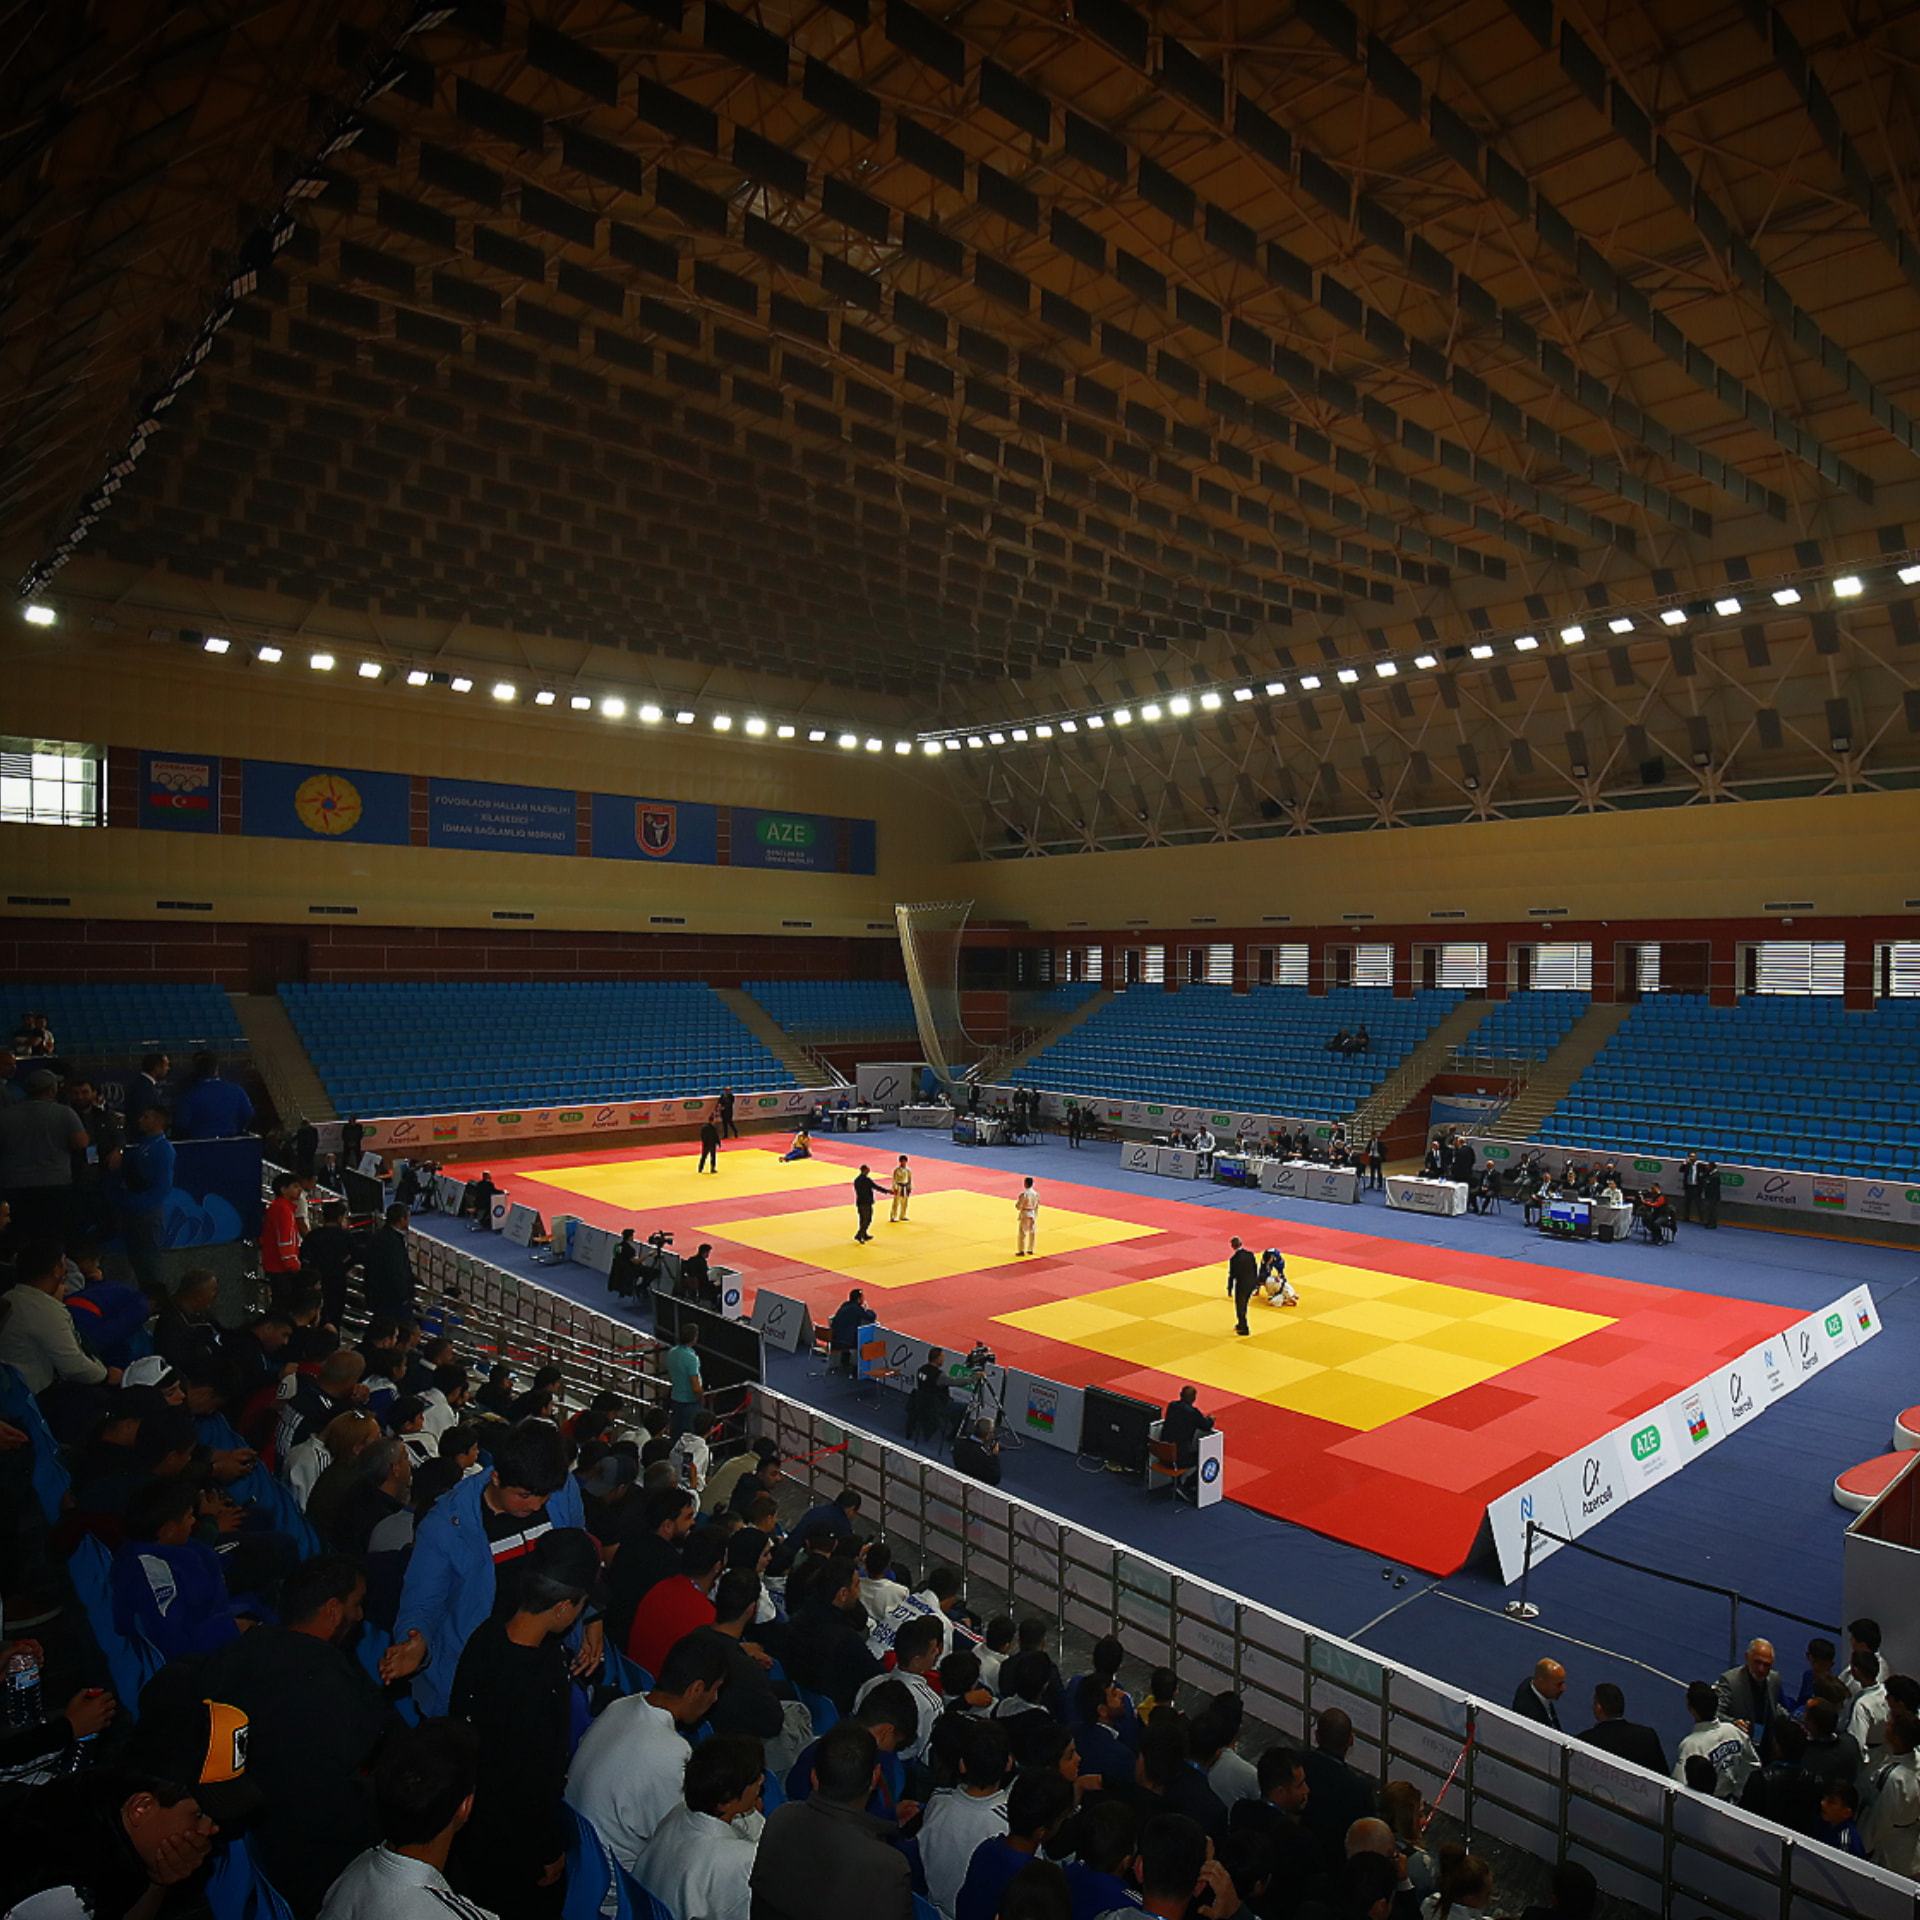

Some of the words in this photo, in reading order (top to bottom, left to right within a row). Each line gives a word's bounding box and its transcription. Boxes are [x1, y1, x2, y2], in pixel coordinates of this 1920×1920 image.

[766, 822, 806, 843] AZE
[1755, 1191, 1797, 1205] Azercell
[1636, 1430, 1659, 1457] AZE
